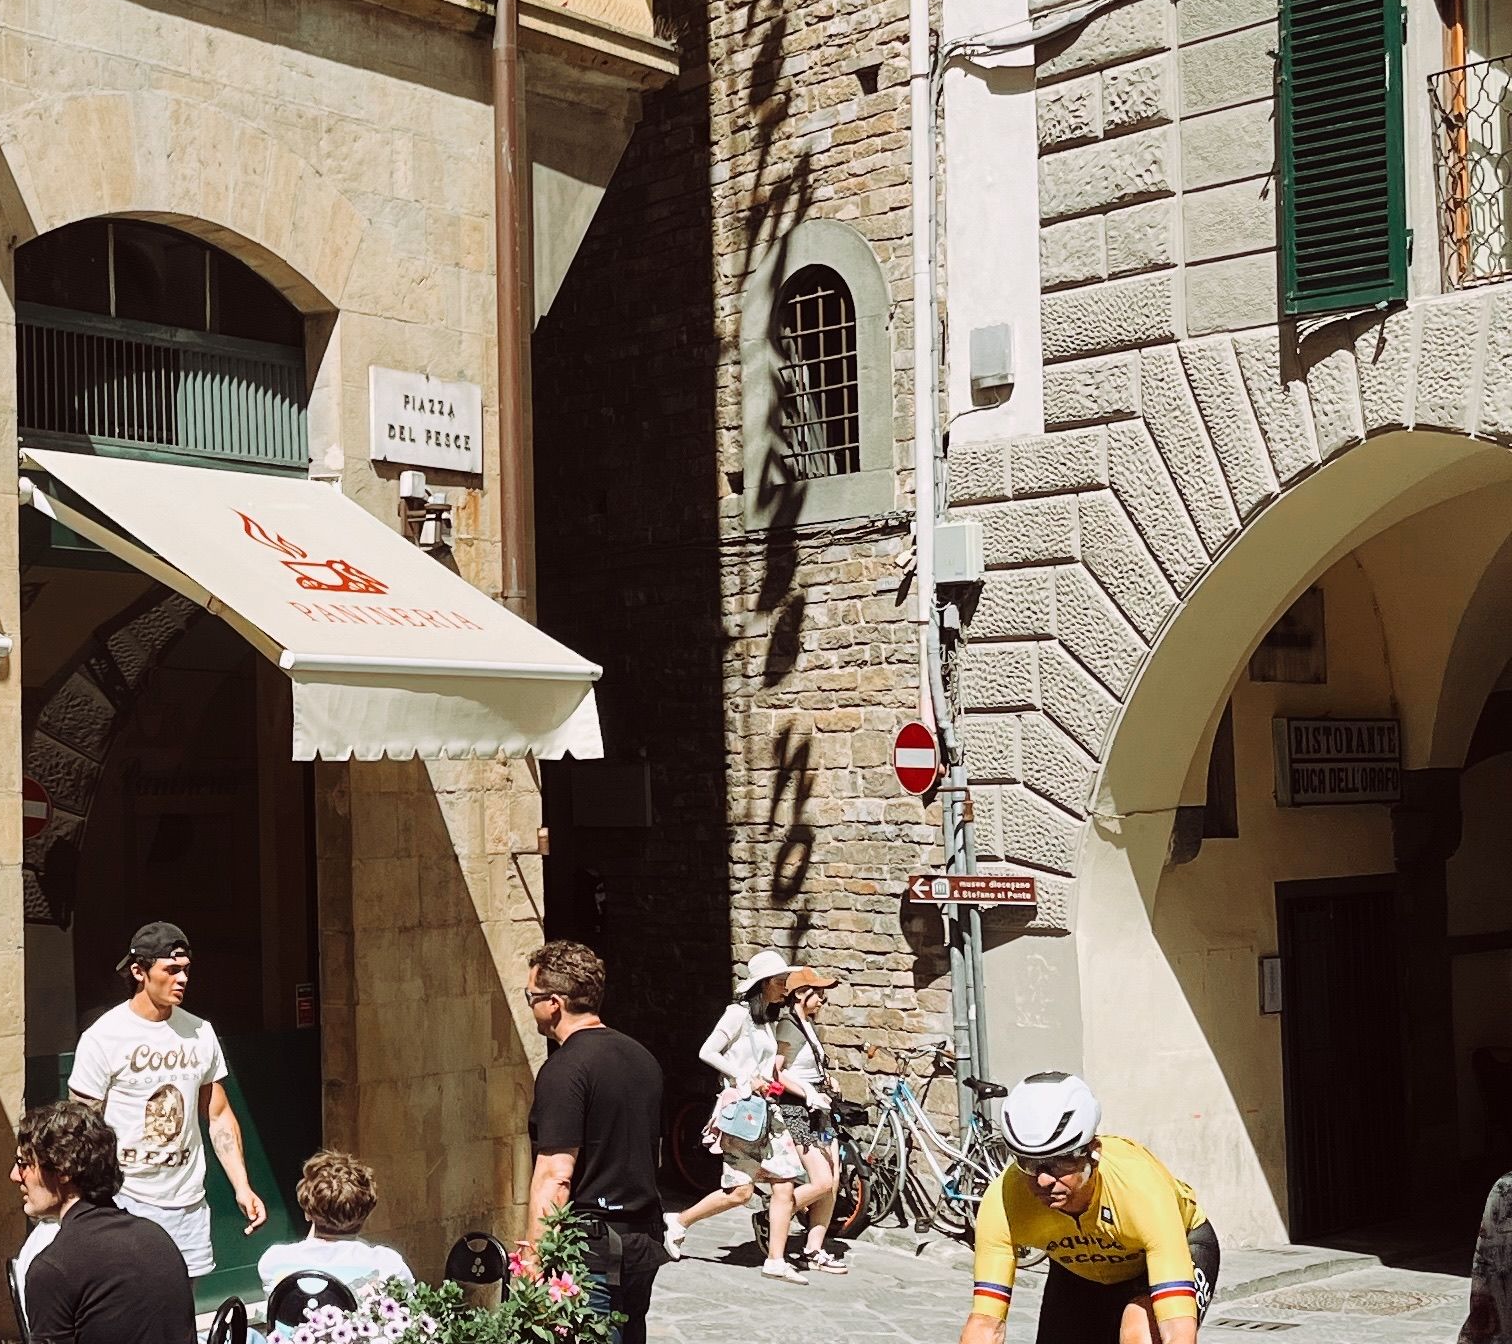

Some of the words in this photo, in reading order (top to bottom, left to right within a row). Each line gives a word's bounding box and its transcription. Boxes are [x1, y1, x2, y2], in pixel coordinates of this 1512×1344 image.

[402, 394, 456, 419] PIAZZA
[387, 423, 416, 444] DEL
[424, 428, 472, 452] PESCE
[288, 599, 484, 632] PANINERIA
[1293, 725, 1398, 755] RISTORANTE
[1293, 767, 1326, 795] BUCA
[1328, 765, 1399, 794] DELL'ORAFO
[958, 880, 986, 888] museo
[126, 1043, 200, 1073] Coors
